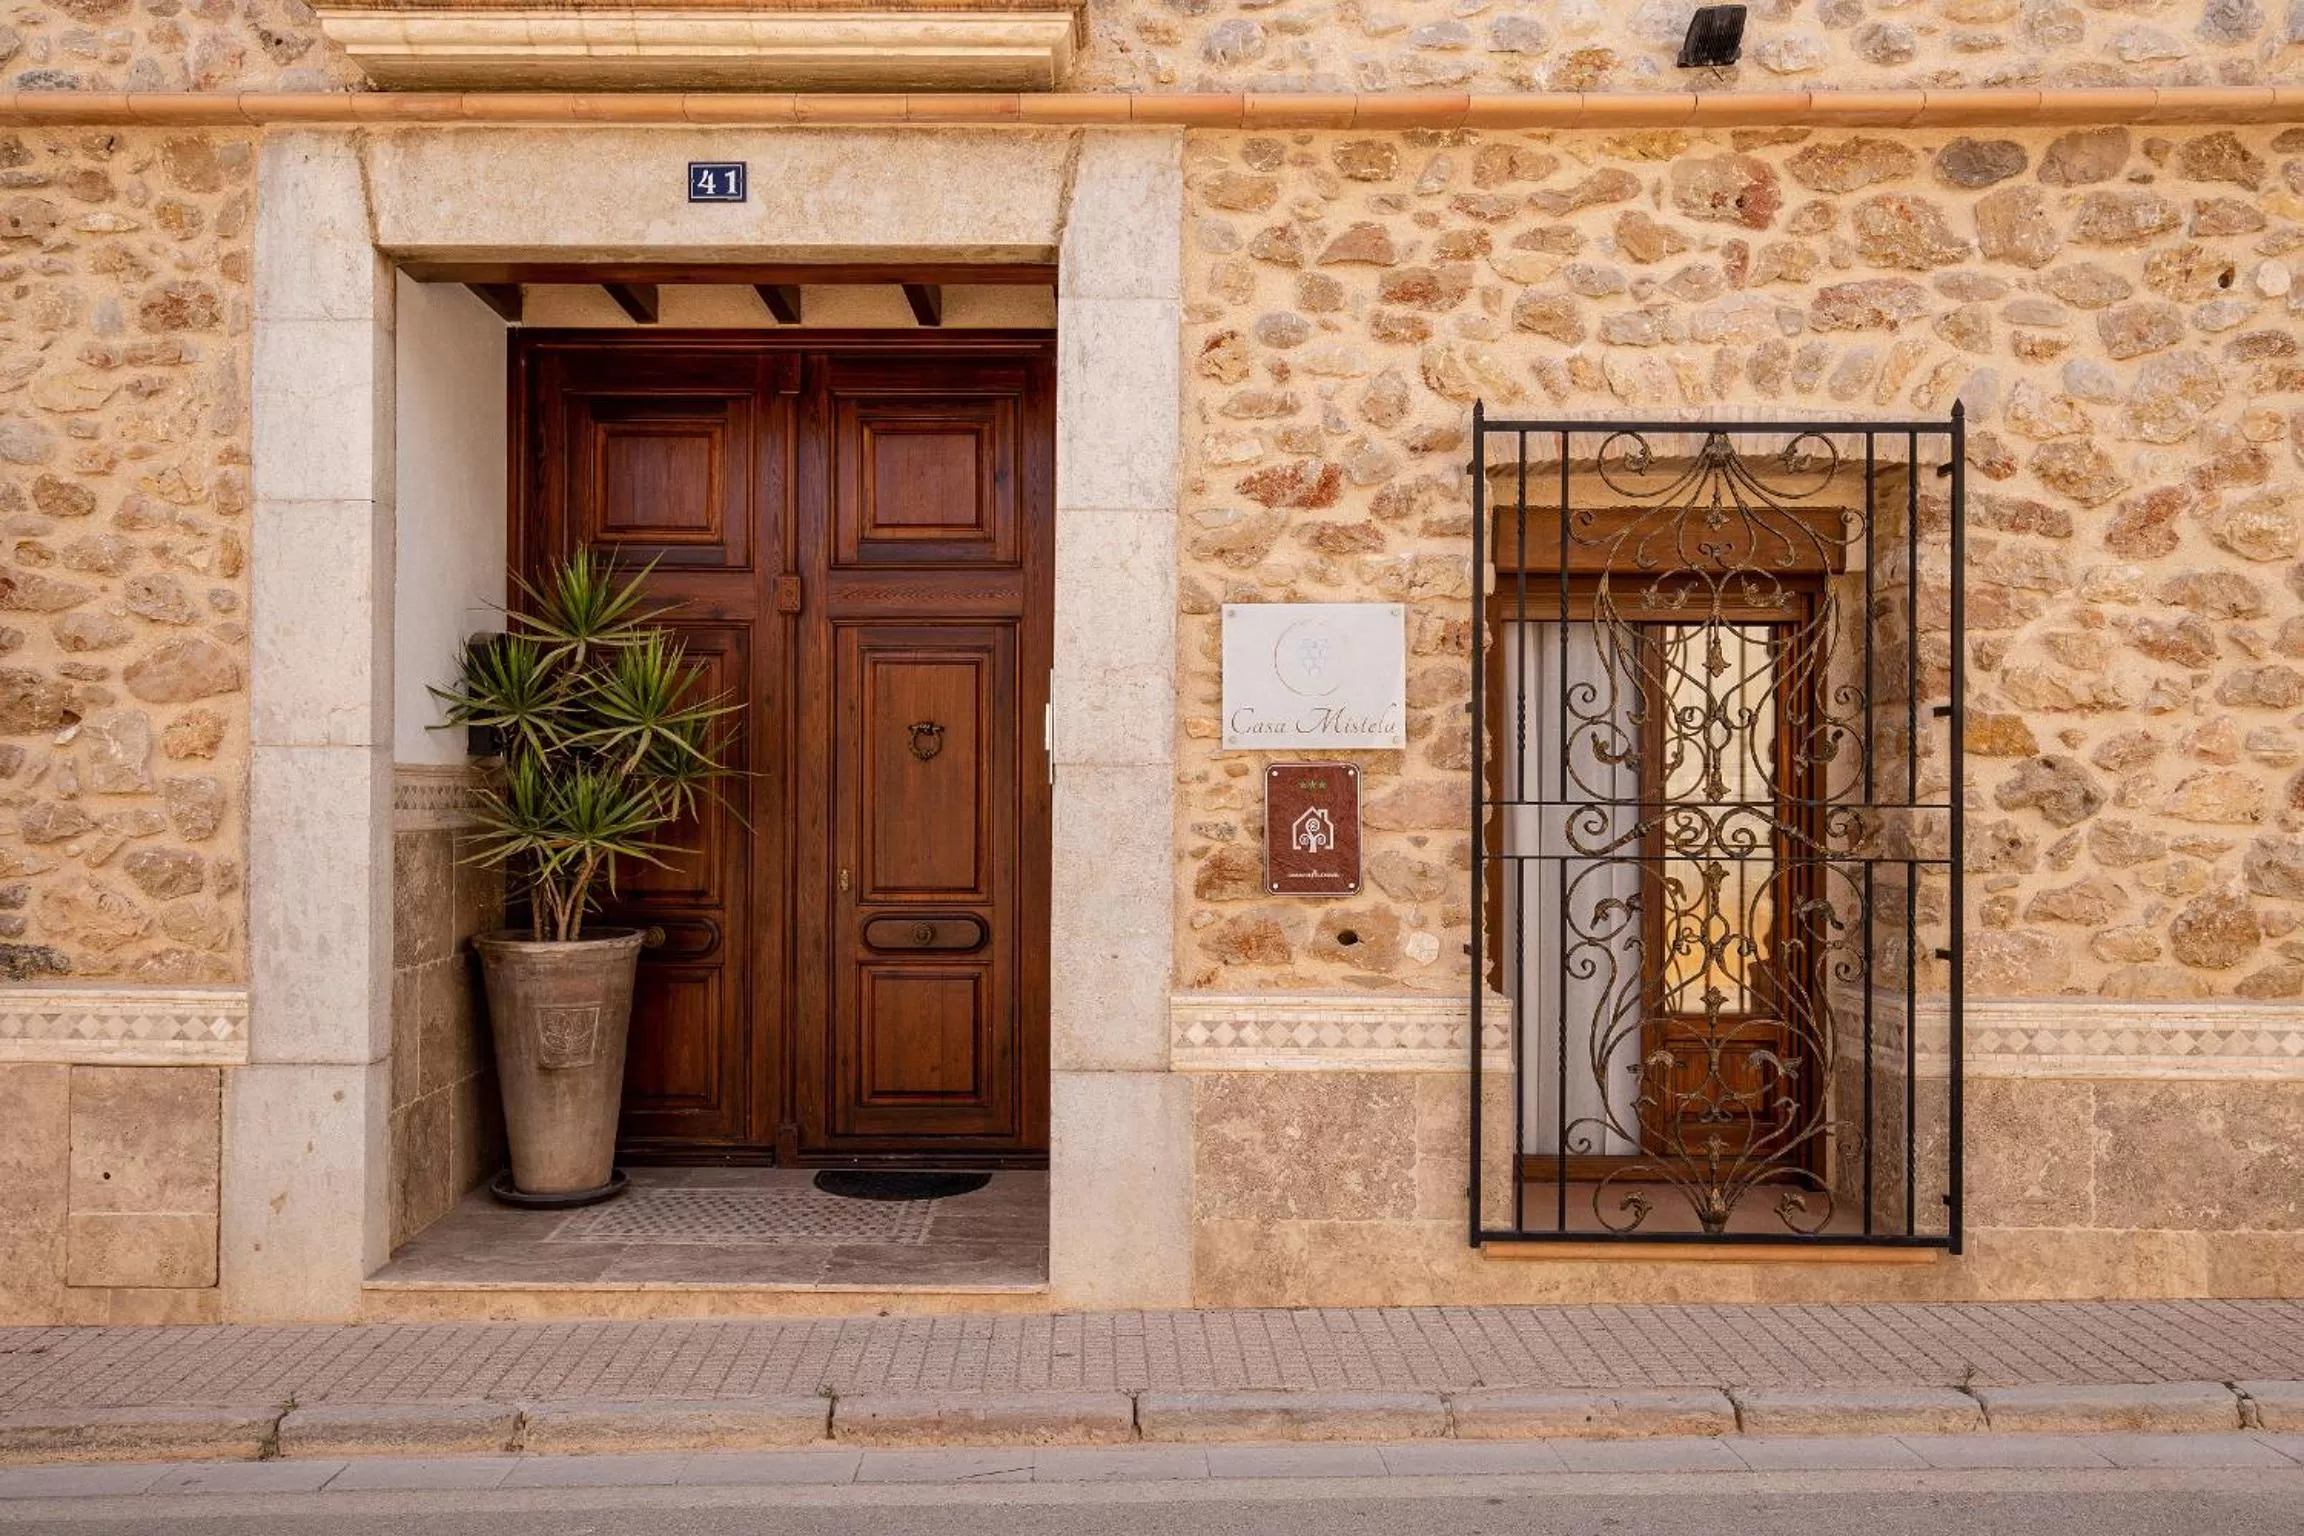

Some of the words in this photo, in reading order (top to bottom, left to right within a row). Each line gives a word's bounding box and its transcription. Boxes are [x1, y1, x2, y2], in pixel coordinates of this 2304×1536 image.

[697, 169, 738, 195] 41
[1231, 707, 1286, 734] Casa
[1296, 702, 1397, 734] Mistela
